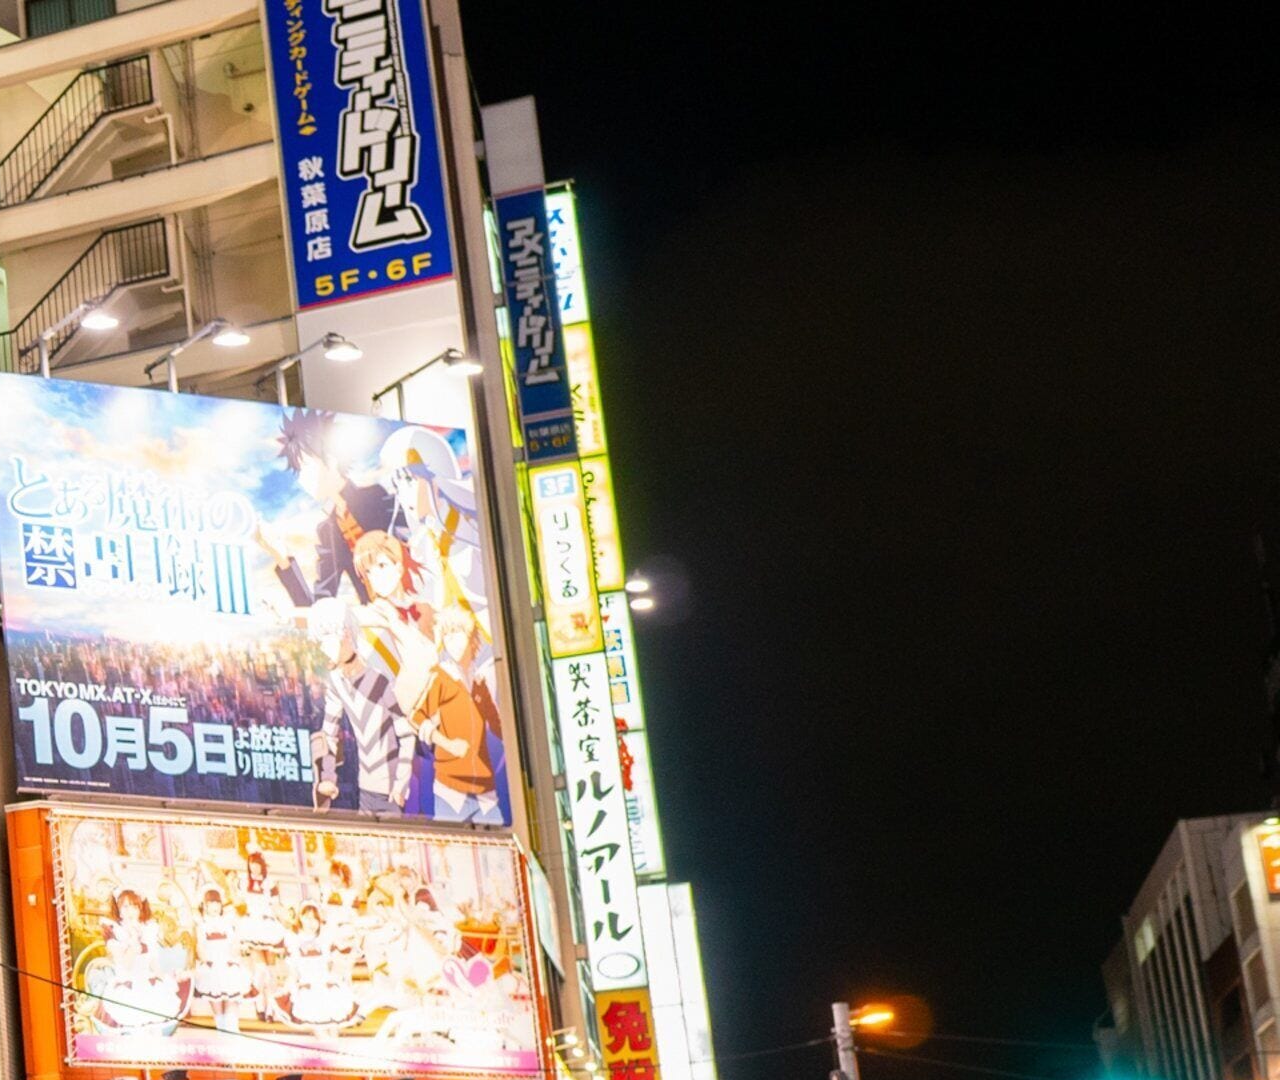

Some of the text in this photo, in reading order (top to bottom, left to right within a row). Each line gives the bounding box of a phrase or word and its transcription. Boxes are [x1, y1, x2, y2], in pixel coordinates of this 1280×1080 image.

[297, 156, 333, 262] 秋葉原店
[542, 476, 572, 497] 3F
[16, 677, 80, 700] TOKYO
[18, 696, 238, 777] 10月5日
